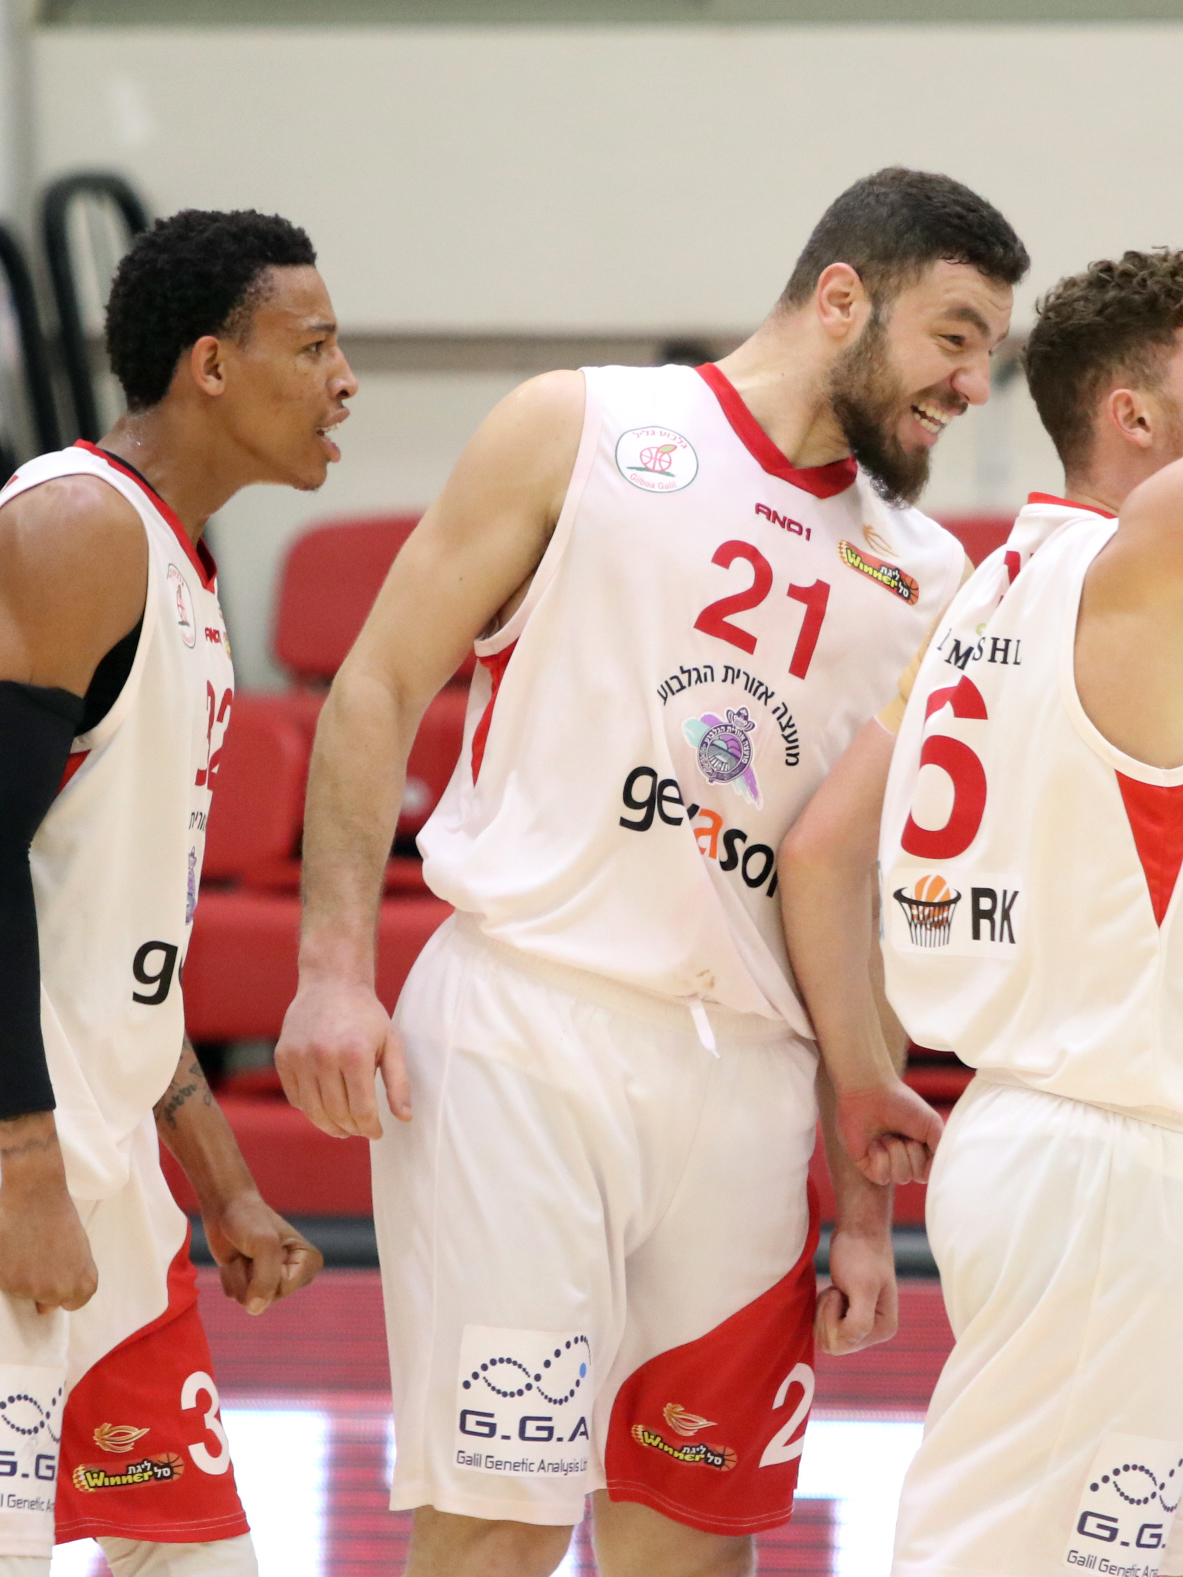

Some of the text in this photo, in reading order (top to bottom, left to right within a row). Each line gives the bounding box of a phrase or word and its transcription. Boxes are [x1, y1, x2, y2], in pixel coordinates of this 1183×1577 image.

[629, 473, 678, 490] Gilboa Galil
[755, 502, 812, 541] AND1
[846, 548, 898, 588] Winner
[693, 539, 831, 681] 21
[656, 664, 800, 767] מועצה אזורית הגלבוע
[900, 673, 989, 861] 6
[969, 886, 1020, 945] RK
[180, 1370, 231, 1476] 3
[127, 1460, 152, 1474] ליגת
[456, 1450, 482, 1468] Galil
[484, 1455, 535, 1473] Genetic
[537, 1458, 579, 1476] Analysis
[643, 1431, 723, 1466] Winner סל
[84, 1466, 171, 1488] Winner סל
[1067, 1549, 1098, 1569] Galil
